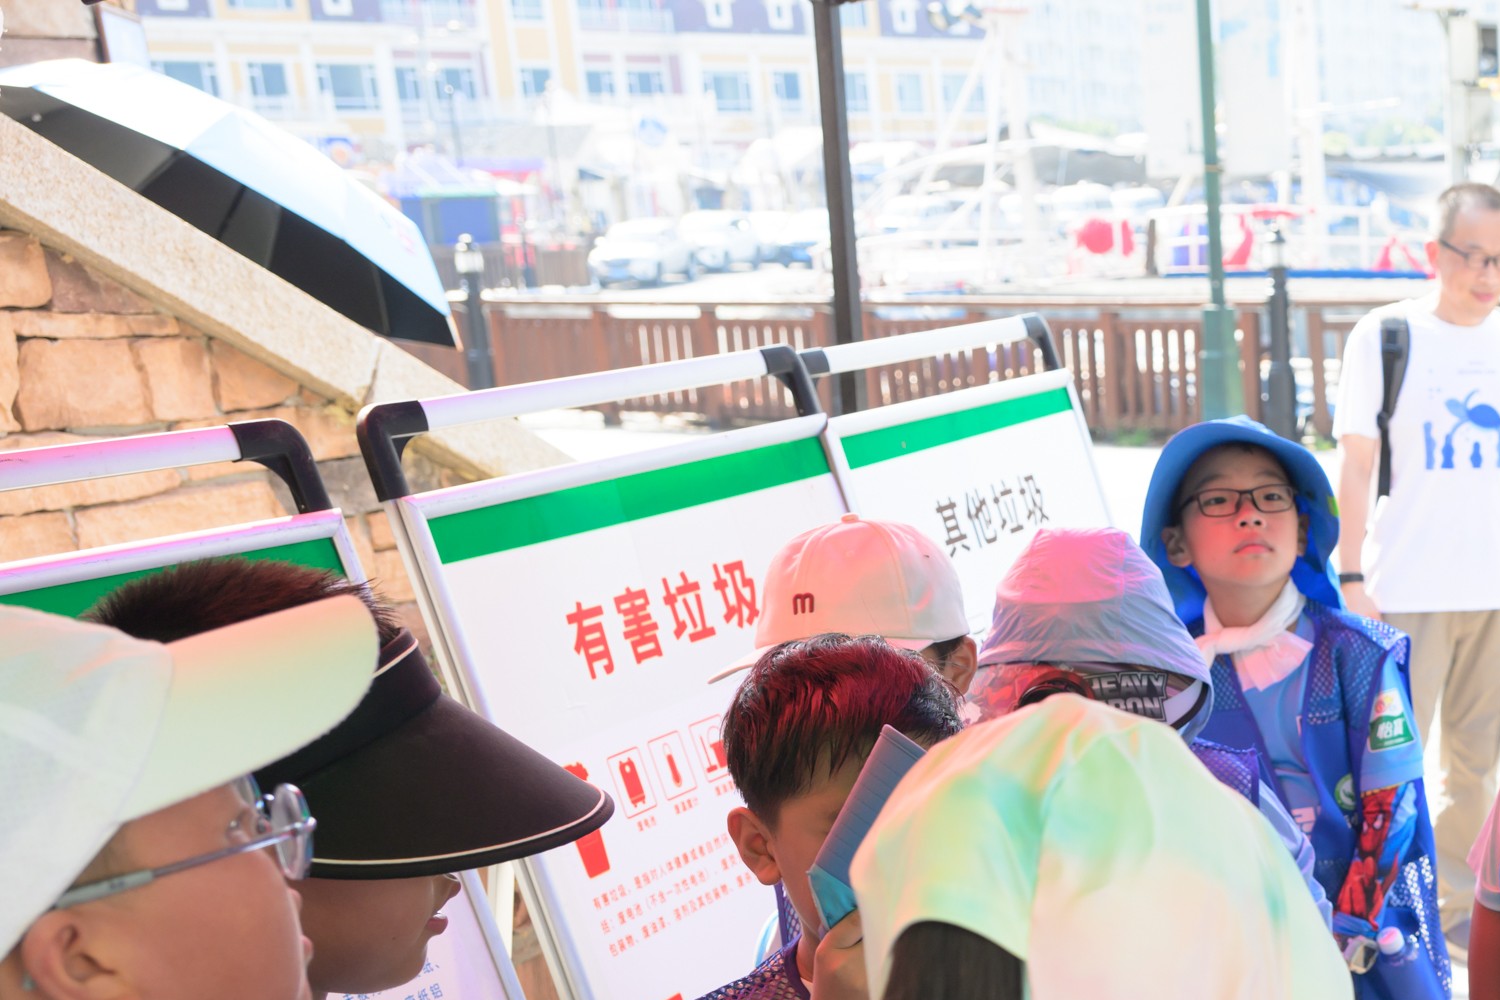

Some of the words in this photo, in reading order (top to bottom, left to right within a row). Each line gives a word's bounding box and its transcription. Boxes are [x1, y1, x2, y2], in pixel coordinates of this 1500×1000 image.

[936, 475, 1049, 558] 其他垃圾
[566, 560, 760, 680] 有害垃圾
[793, 592, 814, 616] m
